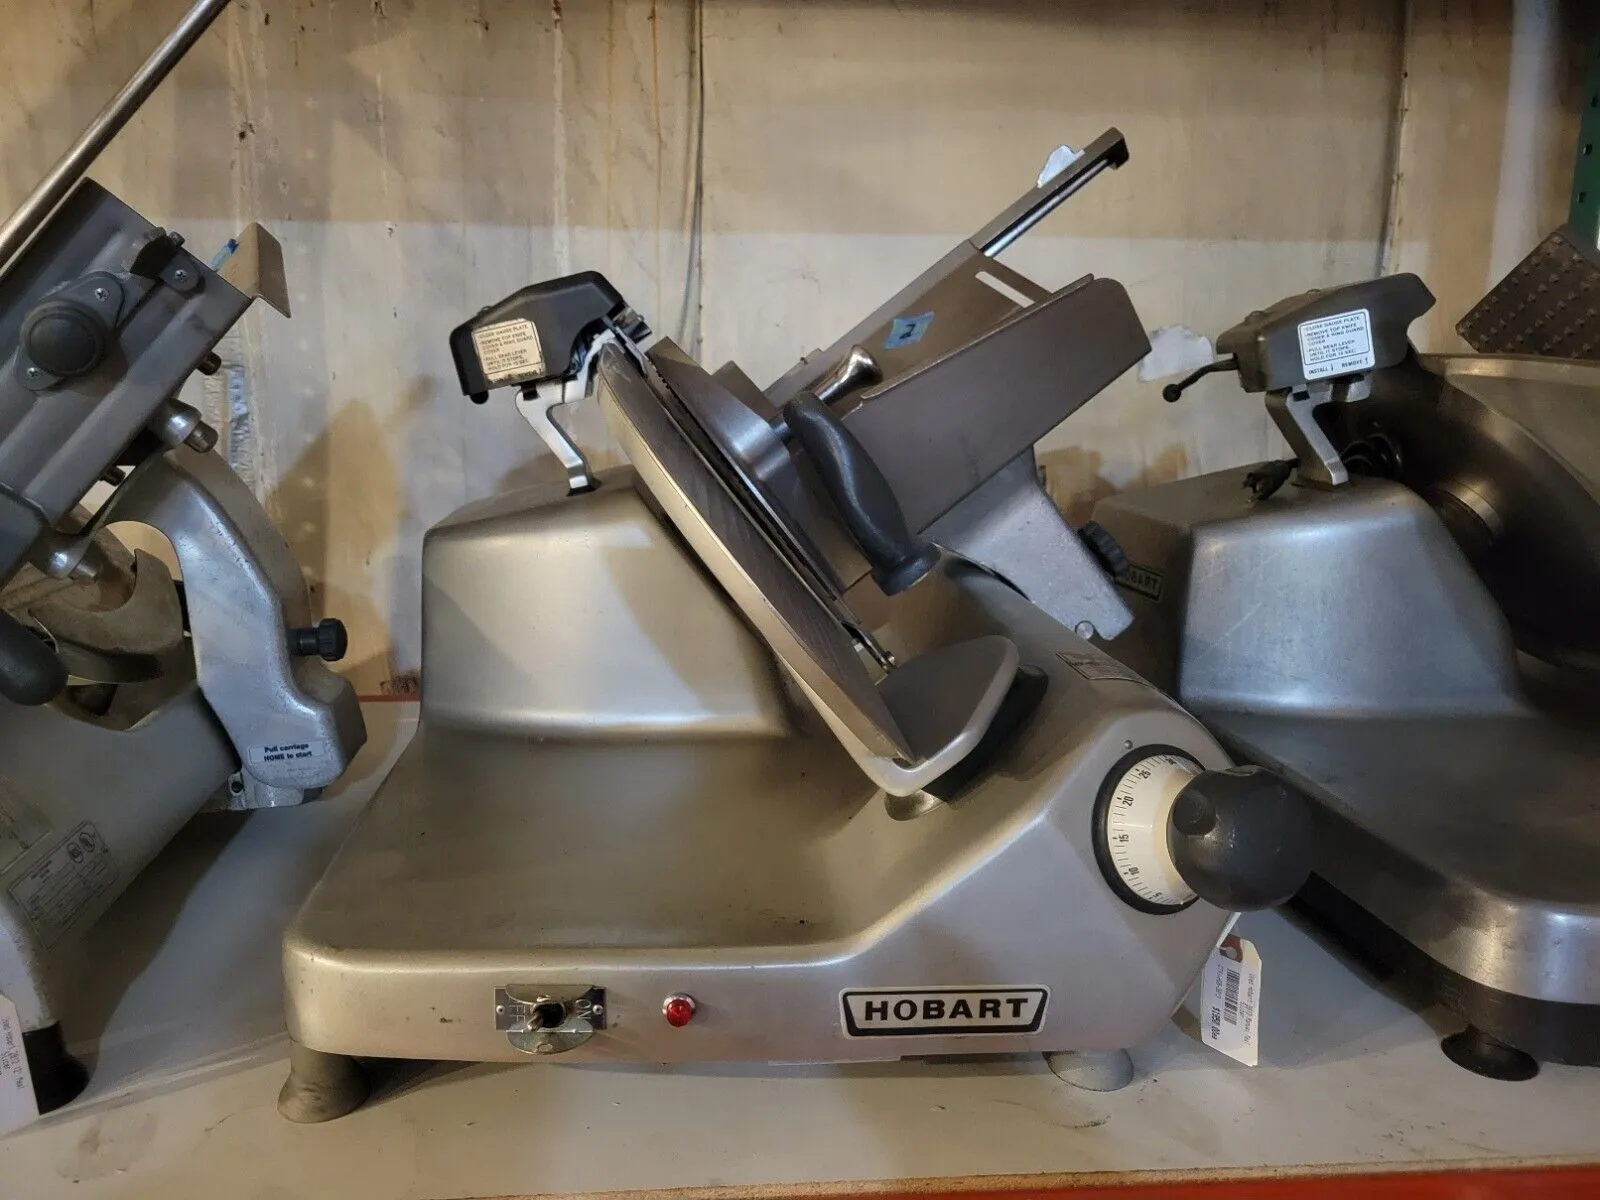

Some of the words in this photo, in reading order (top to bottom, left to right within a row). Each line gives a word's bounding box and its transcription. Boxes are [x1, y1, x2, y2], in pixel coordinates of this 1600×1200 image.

[1307, 329, 1328, 337] REMOVE
[264, 745, 278, 753] Pull
[280, 743, 309, 752] carriage
[264, 753, 285, 762] HOME
[295, 751, 312, 759] start
[1139, 770, 1151, 780] 25
[1122, 796, 1135, 807] 20
[1119, 834, 1130, 843] 15
[1129, 866, 1140, 876] 10
[575, 998, 592, 1019] ON
[864, 998, 1029, 1021] HOBART
